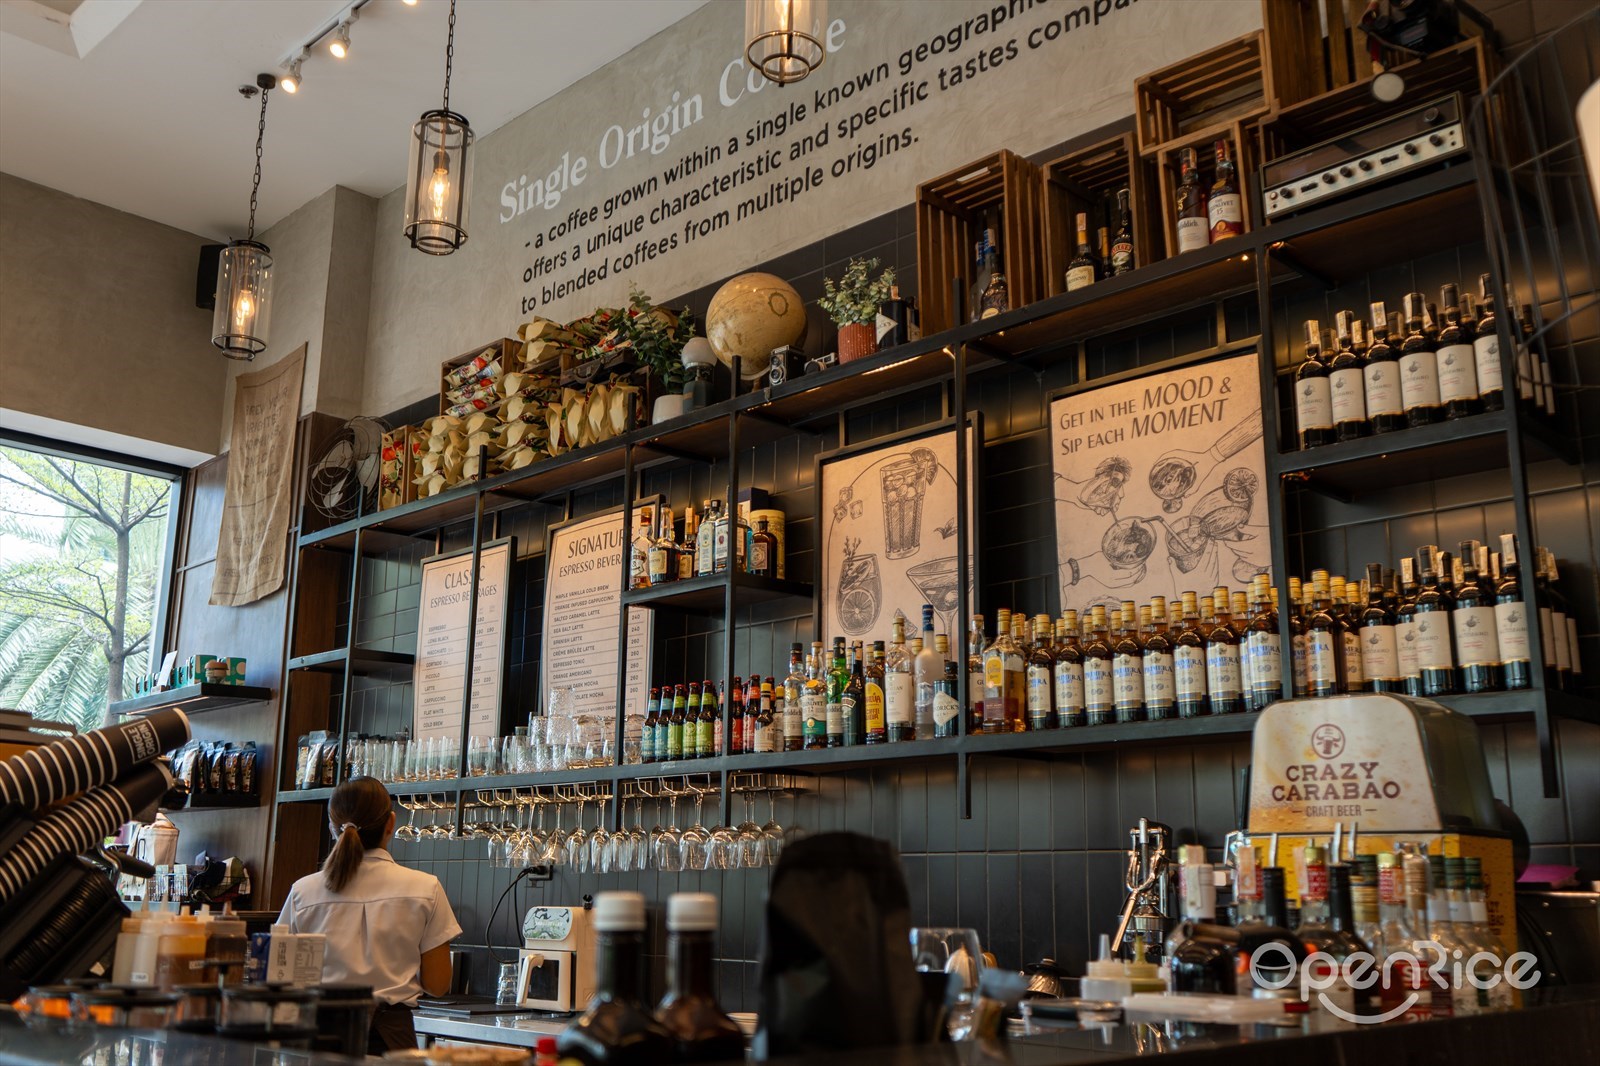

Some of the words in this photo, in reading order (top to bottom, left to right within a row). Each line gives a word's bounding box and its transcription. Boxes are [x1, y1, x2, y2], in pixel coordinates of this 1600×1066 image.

[500, 152, 587, 224] Single
[599, 95, 704, 170] Origin
[719, 17, 846, 107] Coe
[523, 250, 567, 283] offers
[572, 245, 580, 262] a
[587, 214, 644, 255] unique
[650, 150, 781, 225] characteristic
[790, 122, 829, 161] and
[838, 80, 929, 139] specific
[938, 38, 1019, 92] tastes
[535, 233, 543, 249] a
[548, 206, 598, 241] coffee
[603, 176, 657, 219] grown
[664, 145, 721, 185] within
[728, 137, 738, 155] a
[746, 102, 806, 147] single
[814, 62, 889, 113] known
[521, 296, 536, 315] to
[541, 258, 608, 306] blended
[613, 231, 678, 274] coffees
[685, 208, 729, 244] from
[737, 166, 823, 223] multiple
[831, 126, 919, 177] origins.
[1060, 411, 1086, 430] GET
[1090, 406, 1105, 423] IN
[1109, 399, 1136, 418] THE
[1142, 375, 1213, 411] MOOD
[1219, 376, 1232, 395] &
[1061, 437, 1082, 456] SIP
[1087, 427, 1124, 449] EACH
[1131, 397, 1229, 439] MOMENT
[568, 528, 626, 559] SIGNATUR
[444, 565, 486, 589] CLASC
[559, 559, 595, 578] ESPRESSO
[596, 553, 622, 569] BEVER
[430, 592, 460, 608] ESPRESSO
[462, 584, 497, 602] BERAGES
[569, 612, 587, 620] CARAMEL
[553, 672, 568, 680] ORANGE
[569, 669, 592, 677] AMERICANO
[128, 726, 147, 759] SINGLE
[139, 723, 156, 755] ORIGIN
[1286, 762, 1379, 782] CRAZY
[1272, 781, 1401, 801] CARABAO
[1306, 805, 1334, 817] CRAFT
[1337, 804, 1362, 816] BEER
